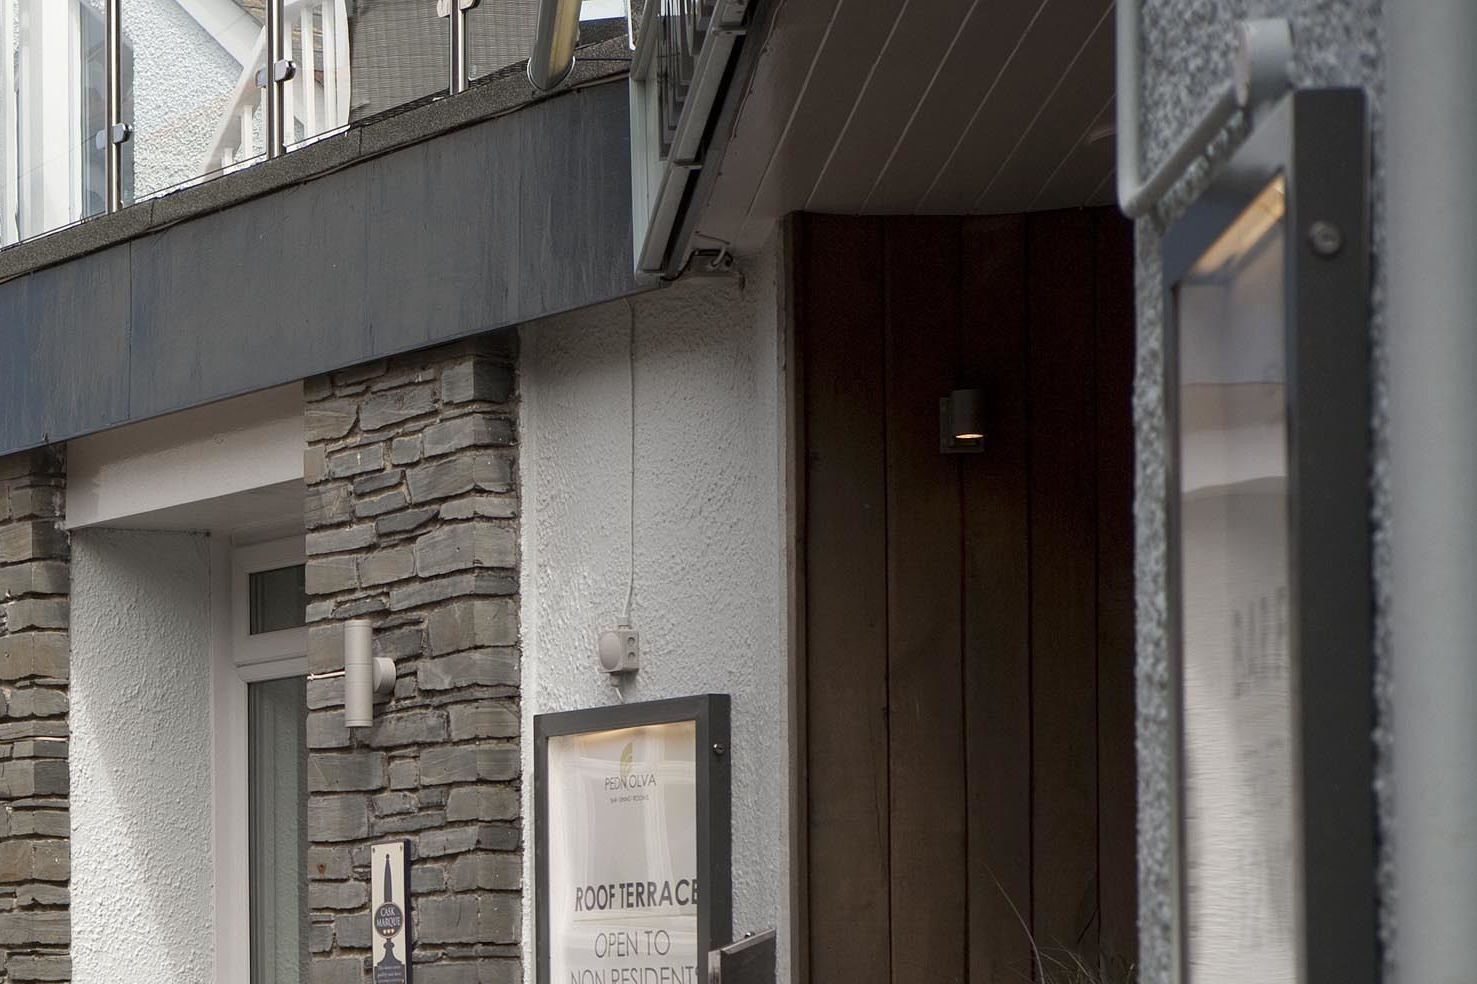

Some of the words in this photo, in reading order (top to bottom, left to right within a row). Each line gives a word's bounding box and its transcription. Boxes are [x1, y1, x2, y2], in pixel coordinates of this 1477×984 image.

[628, 774, 657, 788] OLVA
[575, 884, 616, 912] ROOF
[619, 878, 699, 909] TERRACE
[380, 906, 396, 917] CASK
[376, 916, 401, 928] MARQUE
[595, 932, 639, 958] OPEN
[644, 929, 671, 956] TO
